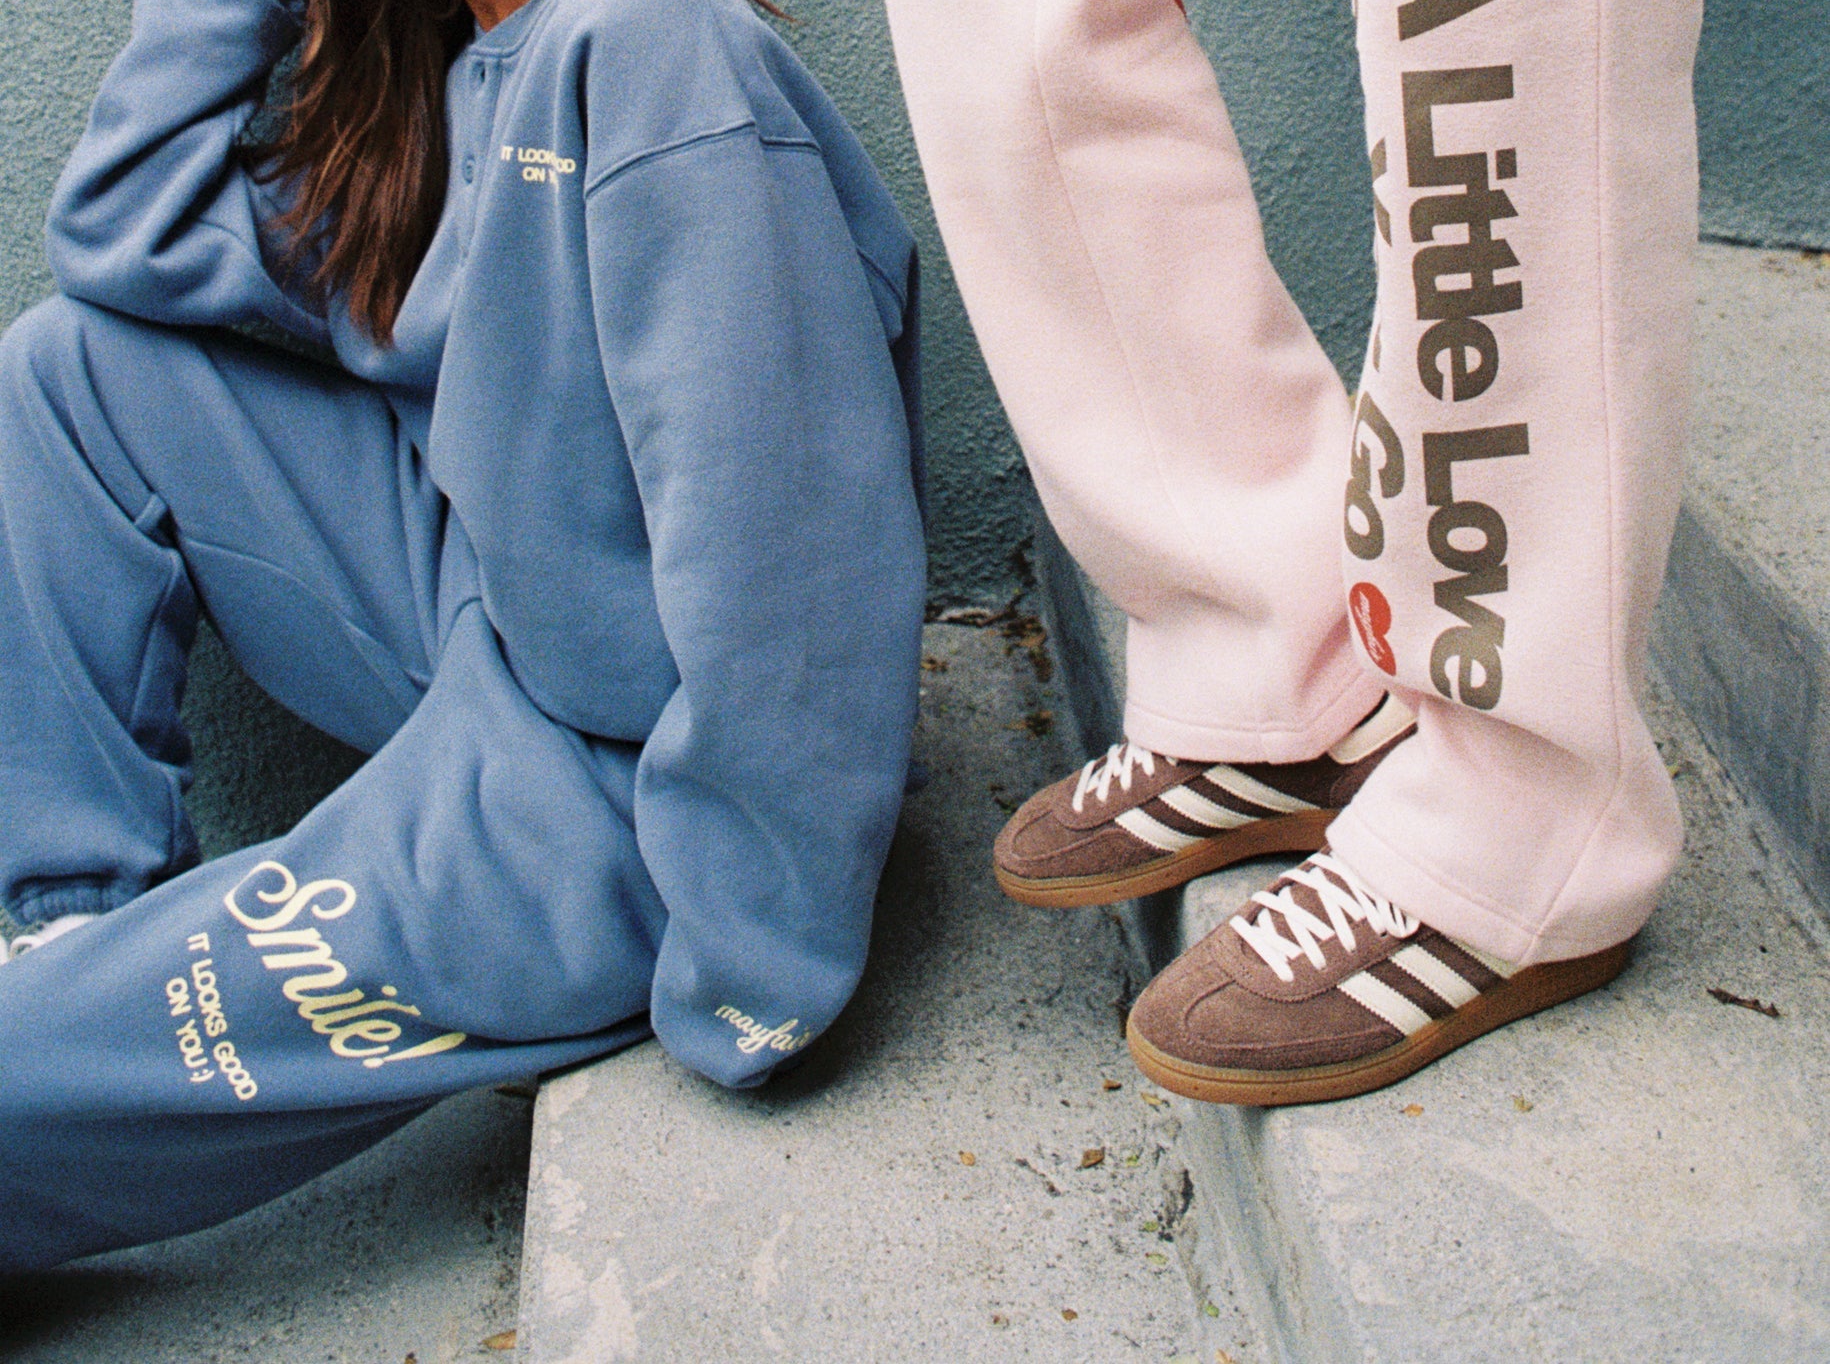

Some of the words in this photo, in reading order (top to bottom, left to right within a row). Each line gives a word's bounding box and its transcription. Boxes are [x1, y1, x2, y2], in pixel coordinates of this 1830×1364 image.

[501, 145, 514, 161] IT
[517, 147, 557, 165] LOOK
[522, 166, 546, 183] ON
[1401, 64, 1524, 403] Little
[1344, 390, 1405, 561] Go
[1422, 422, 1530, 711] Love
[187, 932, 210, 952] IT
[224, 860, 467, 1069] Smile!
[165, 977, 192, 1017] ON
[191, 958, 228, 1038] LOOKS
[213, 1040, 258, 1101] GOOD
